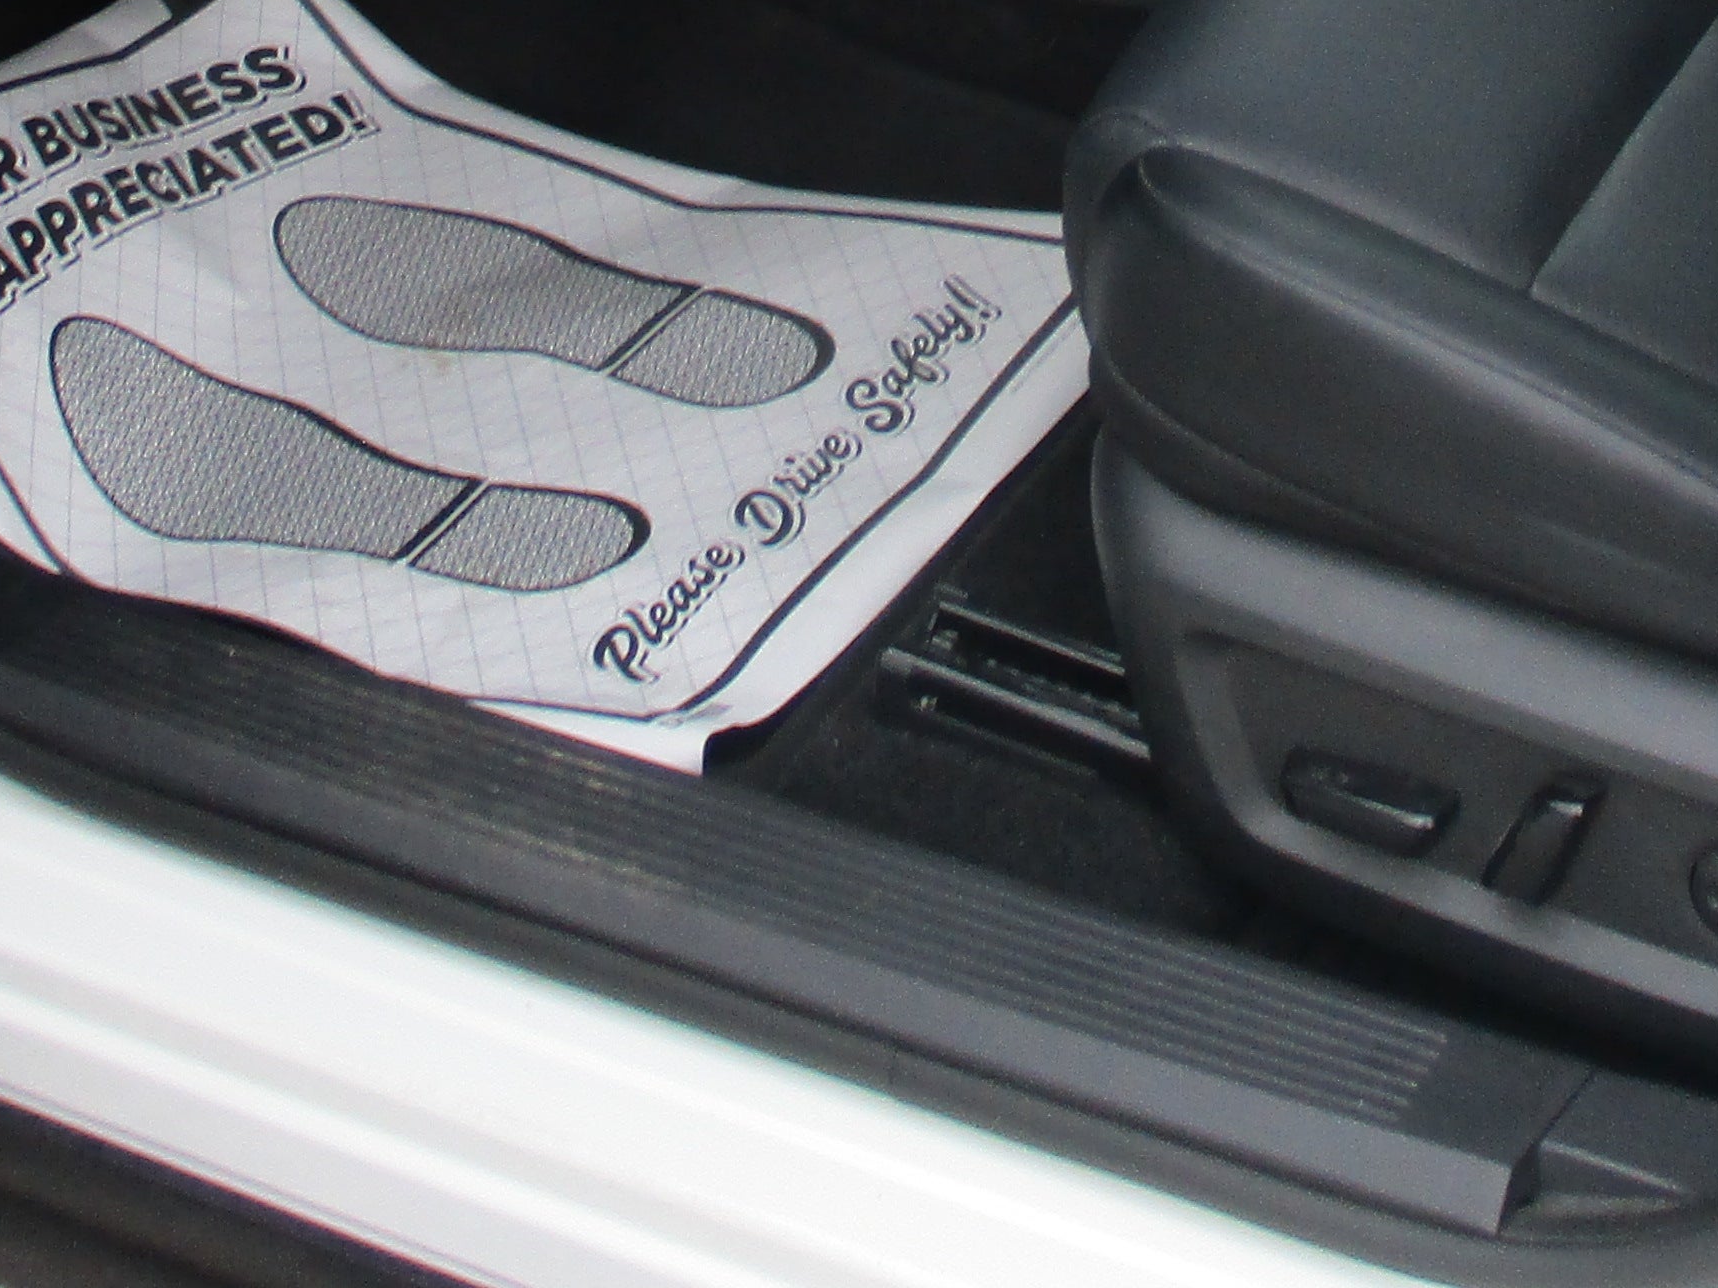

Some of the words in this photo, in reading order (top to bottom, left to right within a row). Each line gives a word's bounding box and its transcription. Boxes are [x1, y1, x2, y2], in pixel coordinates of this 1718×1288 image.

[21, 46, 305, 169] BUSINESS
[592, 542, 745, 684] Please
[733, 430, 863, 548] Drive
[844, 274, 1002, 434] Safely!!
